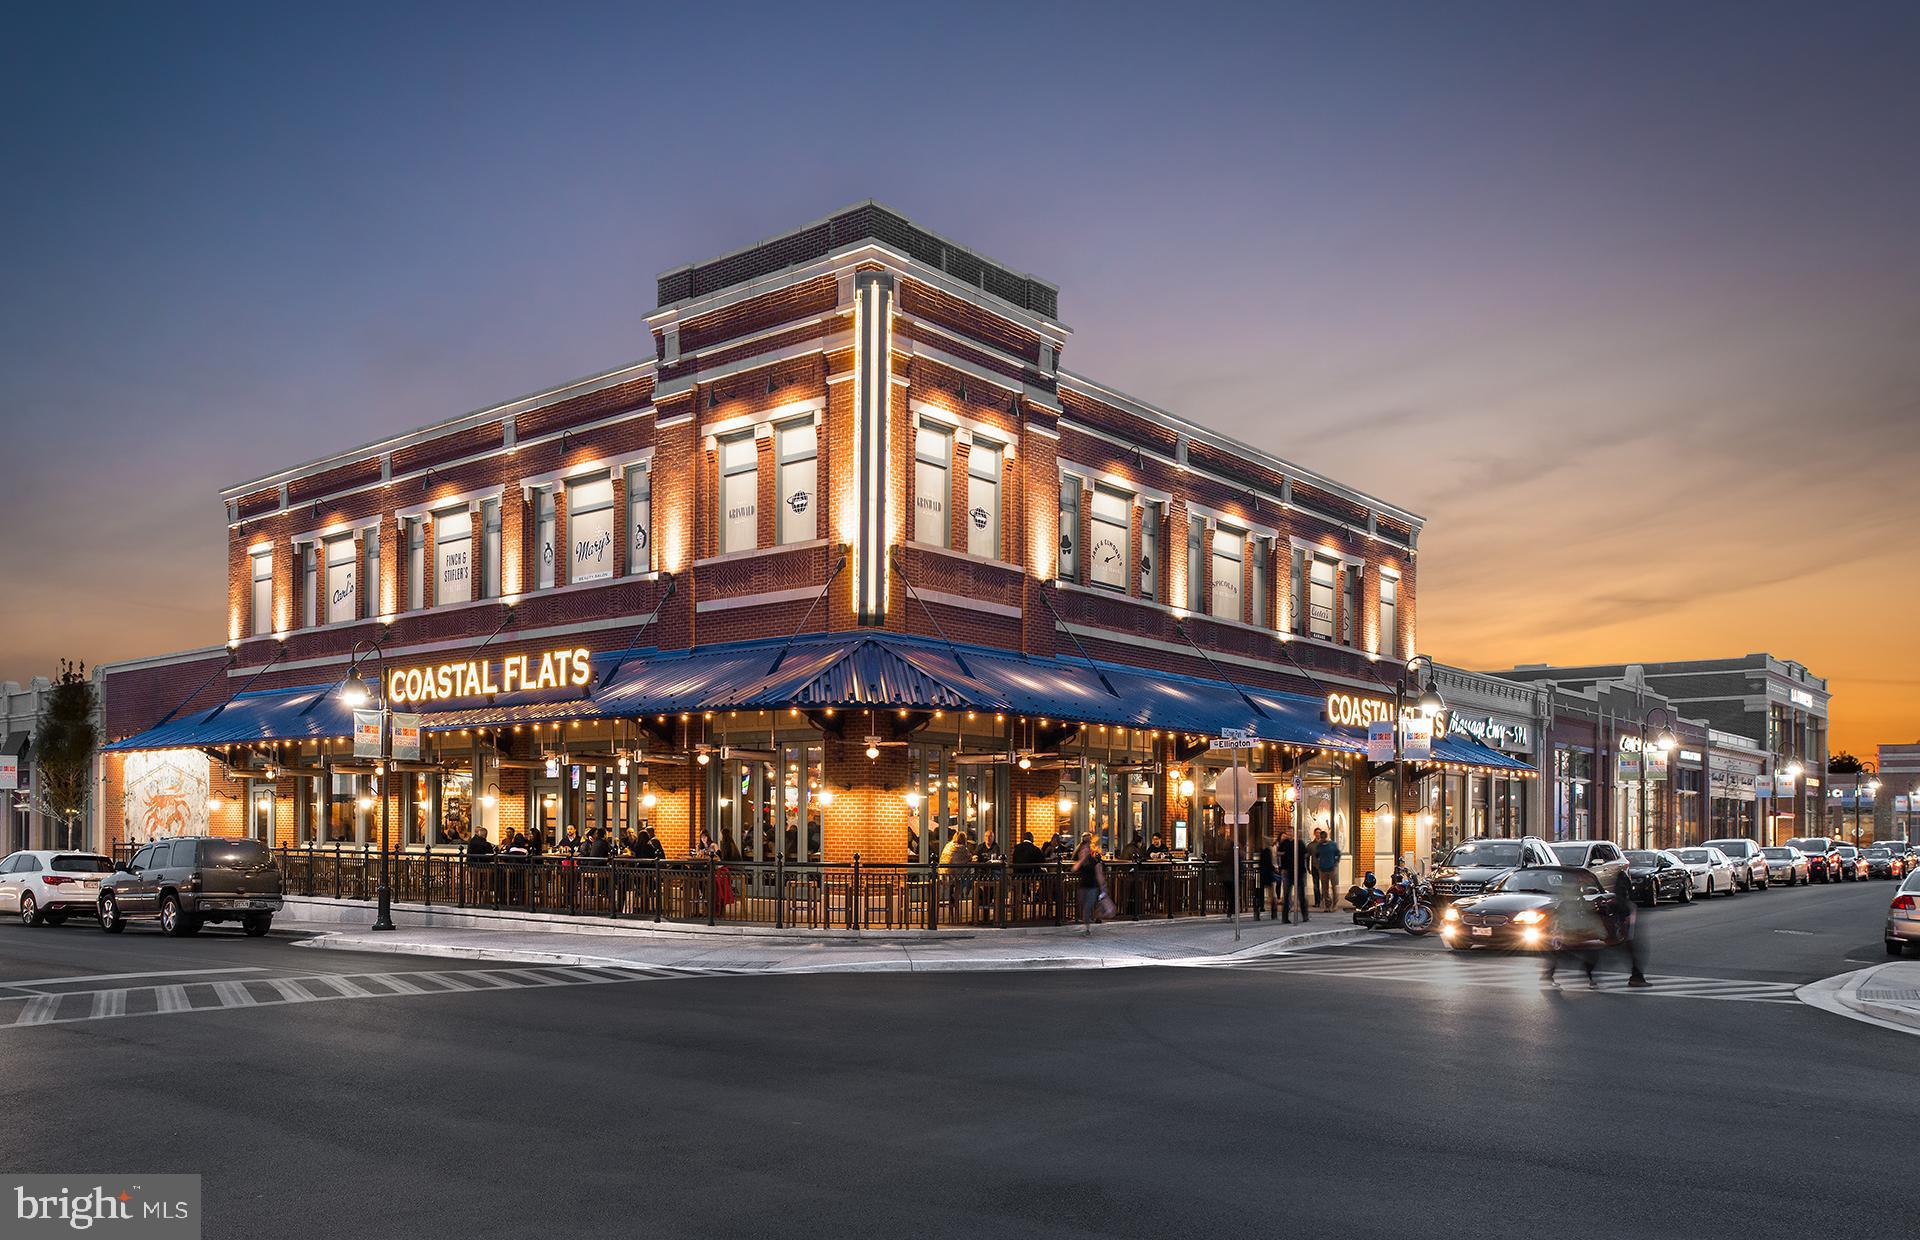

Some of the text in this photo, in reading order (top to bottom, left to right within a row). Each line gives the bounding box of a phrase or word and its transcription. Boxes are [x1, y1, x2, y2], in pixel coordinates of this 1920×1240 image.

[576, 531, 610, 562] Mary's
[446, 551, 467, 566] FINCH &
[444, 566, 468, 582] STIFLER'S
[390, 648, 590, 702] COASTAL FLATS
[1219, 740, 1250, 748] Ellington
[1514, 725, 1527, 745] SPA
